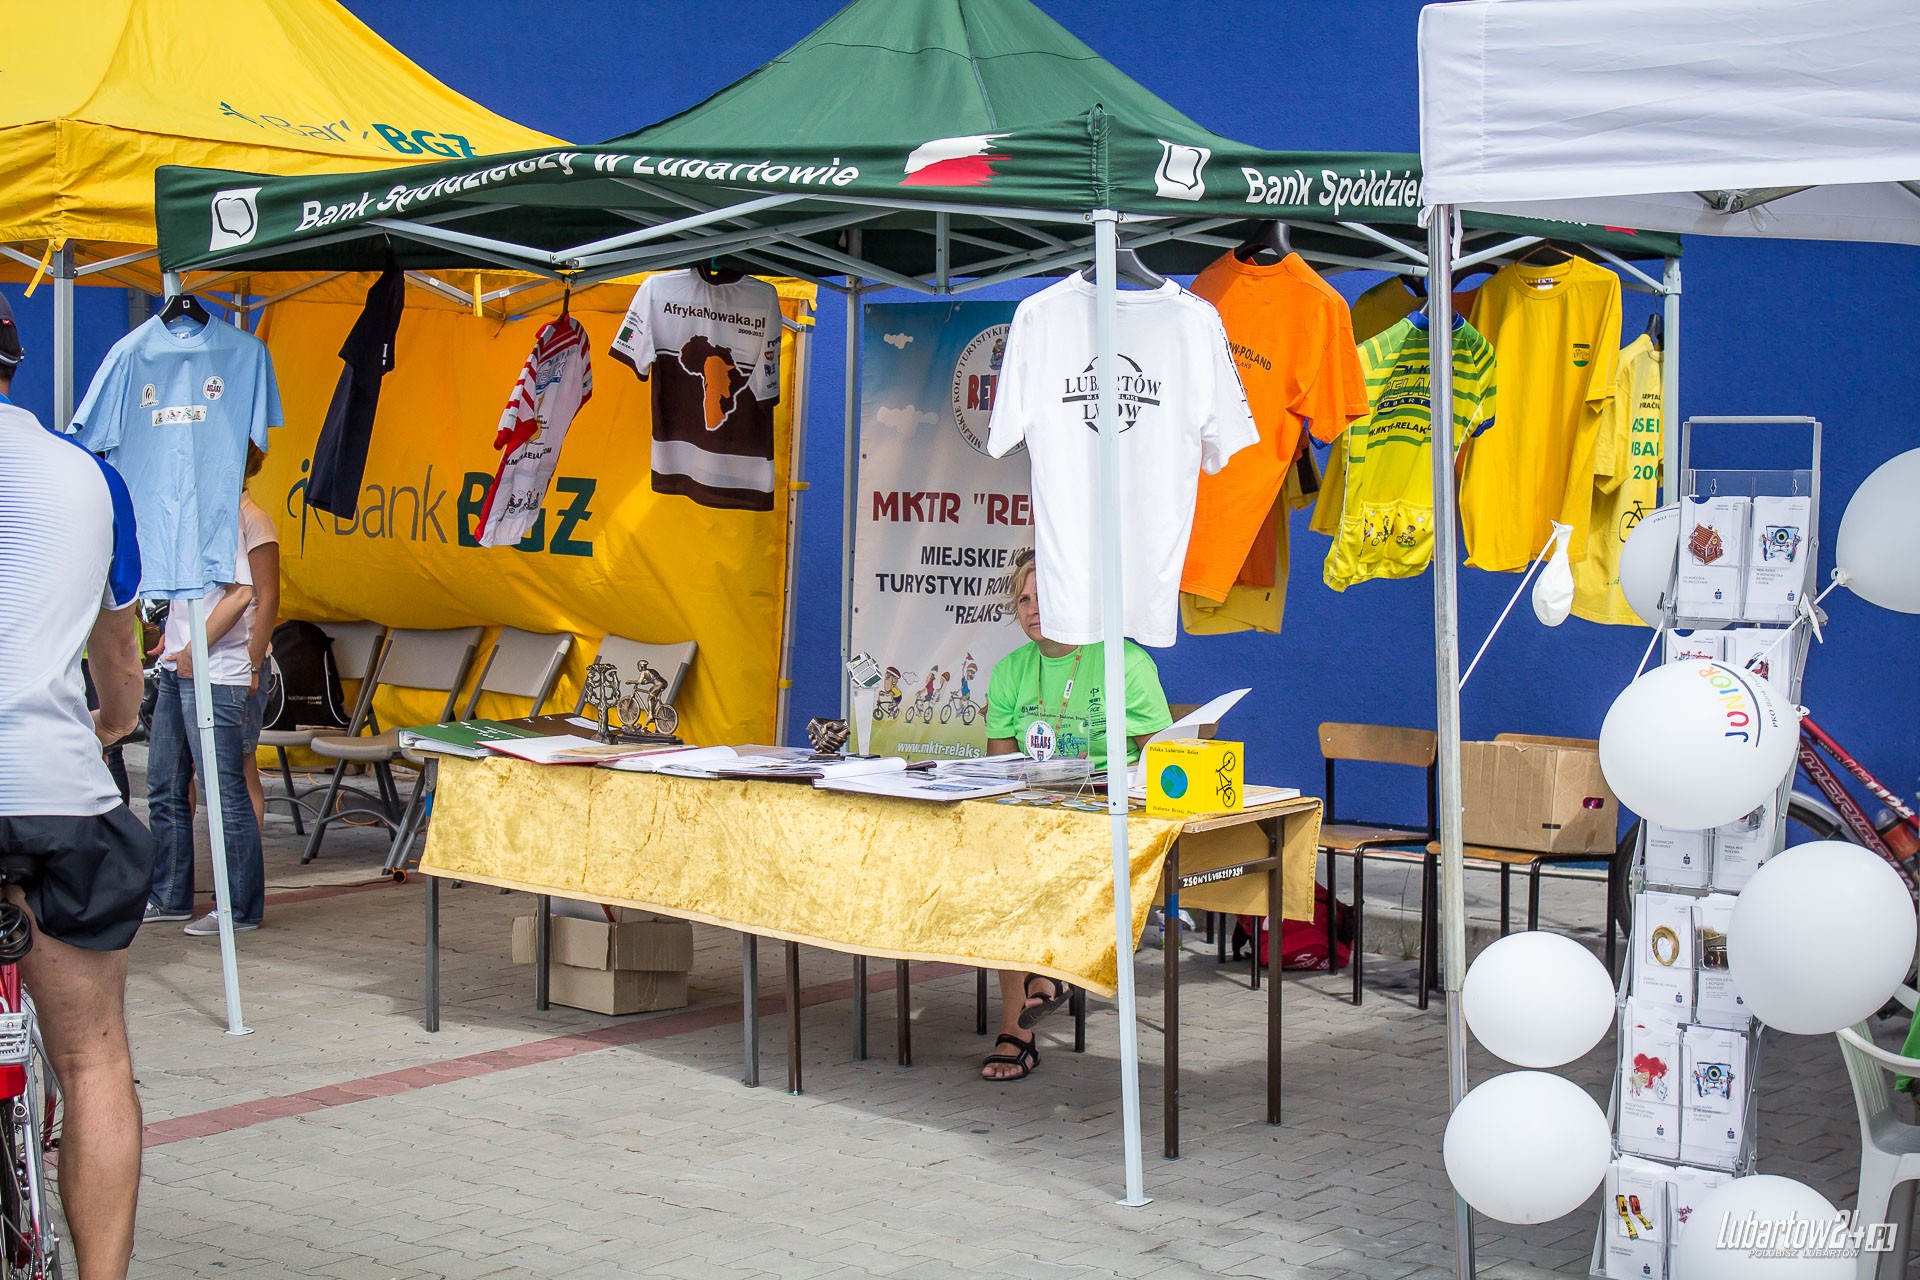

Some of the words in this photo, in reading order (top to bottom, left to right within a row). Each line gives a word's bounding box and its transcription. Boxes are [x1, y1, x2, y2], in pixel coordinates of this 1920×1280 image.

[295, 191, 377, 232] Bank
[594, 153, 631, 172] w
[1240, 166, 1313, 207] Bank
[663, 302, 766, 331] AfrykaNowaka.pl
[872, 490, 961, 524] MKTR
[920, 545, 1007, 568] MIEJSKIE
[875, 573, 982, 596] TURYSTYKI
[1698, 665, 1750, 743] JUNIOR
[1030, 734, 1051, 750] RELAKS
